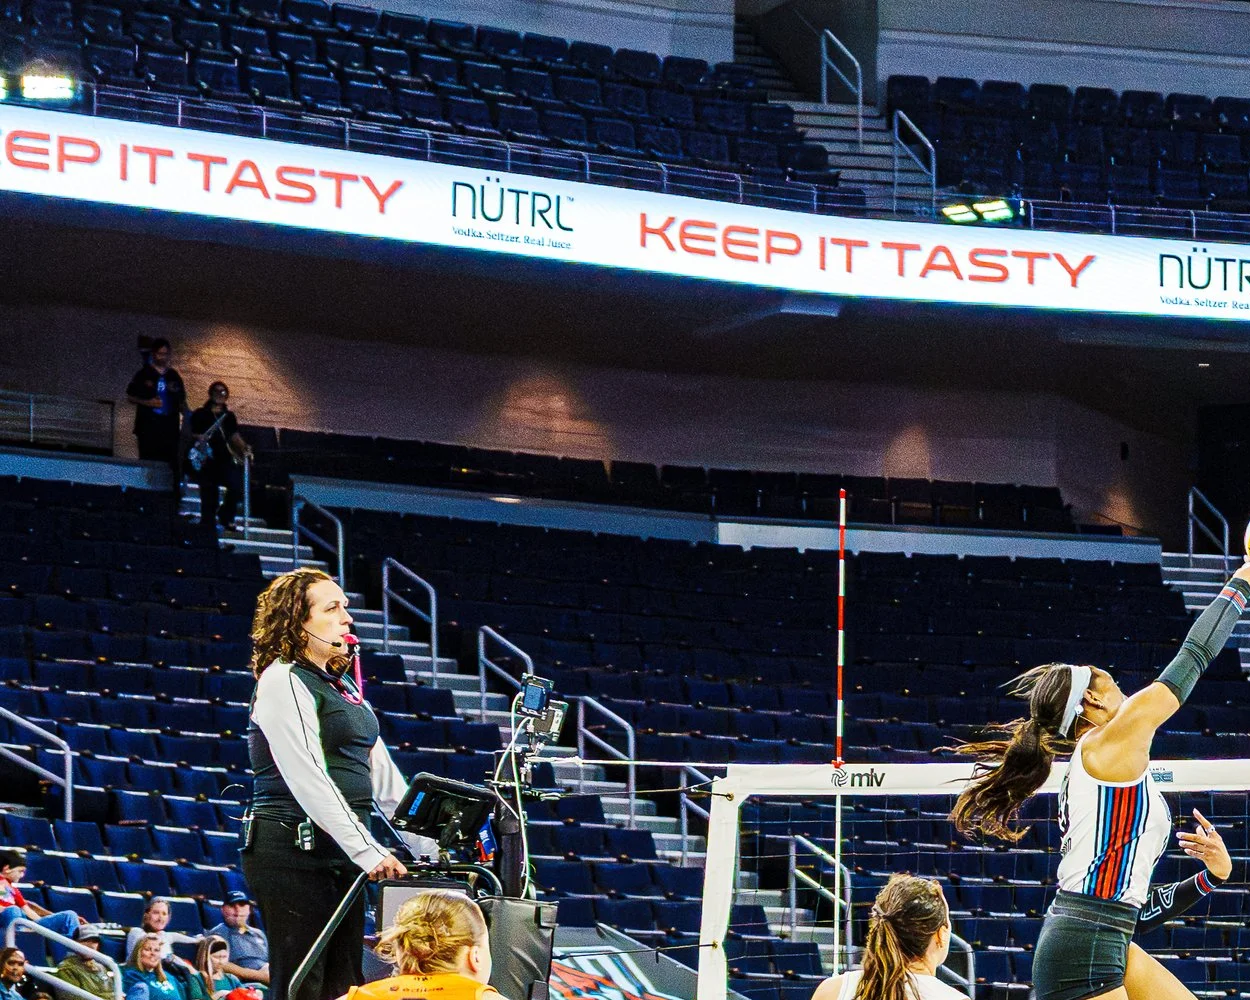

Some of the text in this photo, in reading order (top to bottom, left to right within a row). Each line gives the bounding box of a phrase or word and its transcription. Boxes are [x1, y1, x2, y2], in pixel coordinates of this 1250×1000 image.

[120, 145, 173, 183] IT
[187, 152, 404, 214] TASTY
[640, 213, 1094, 288] KEEP IT TASTY
